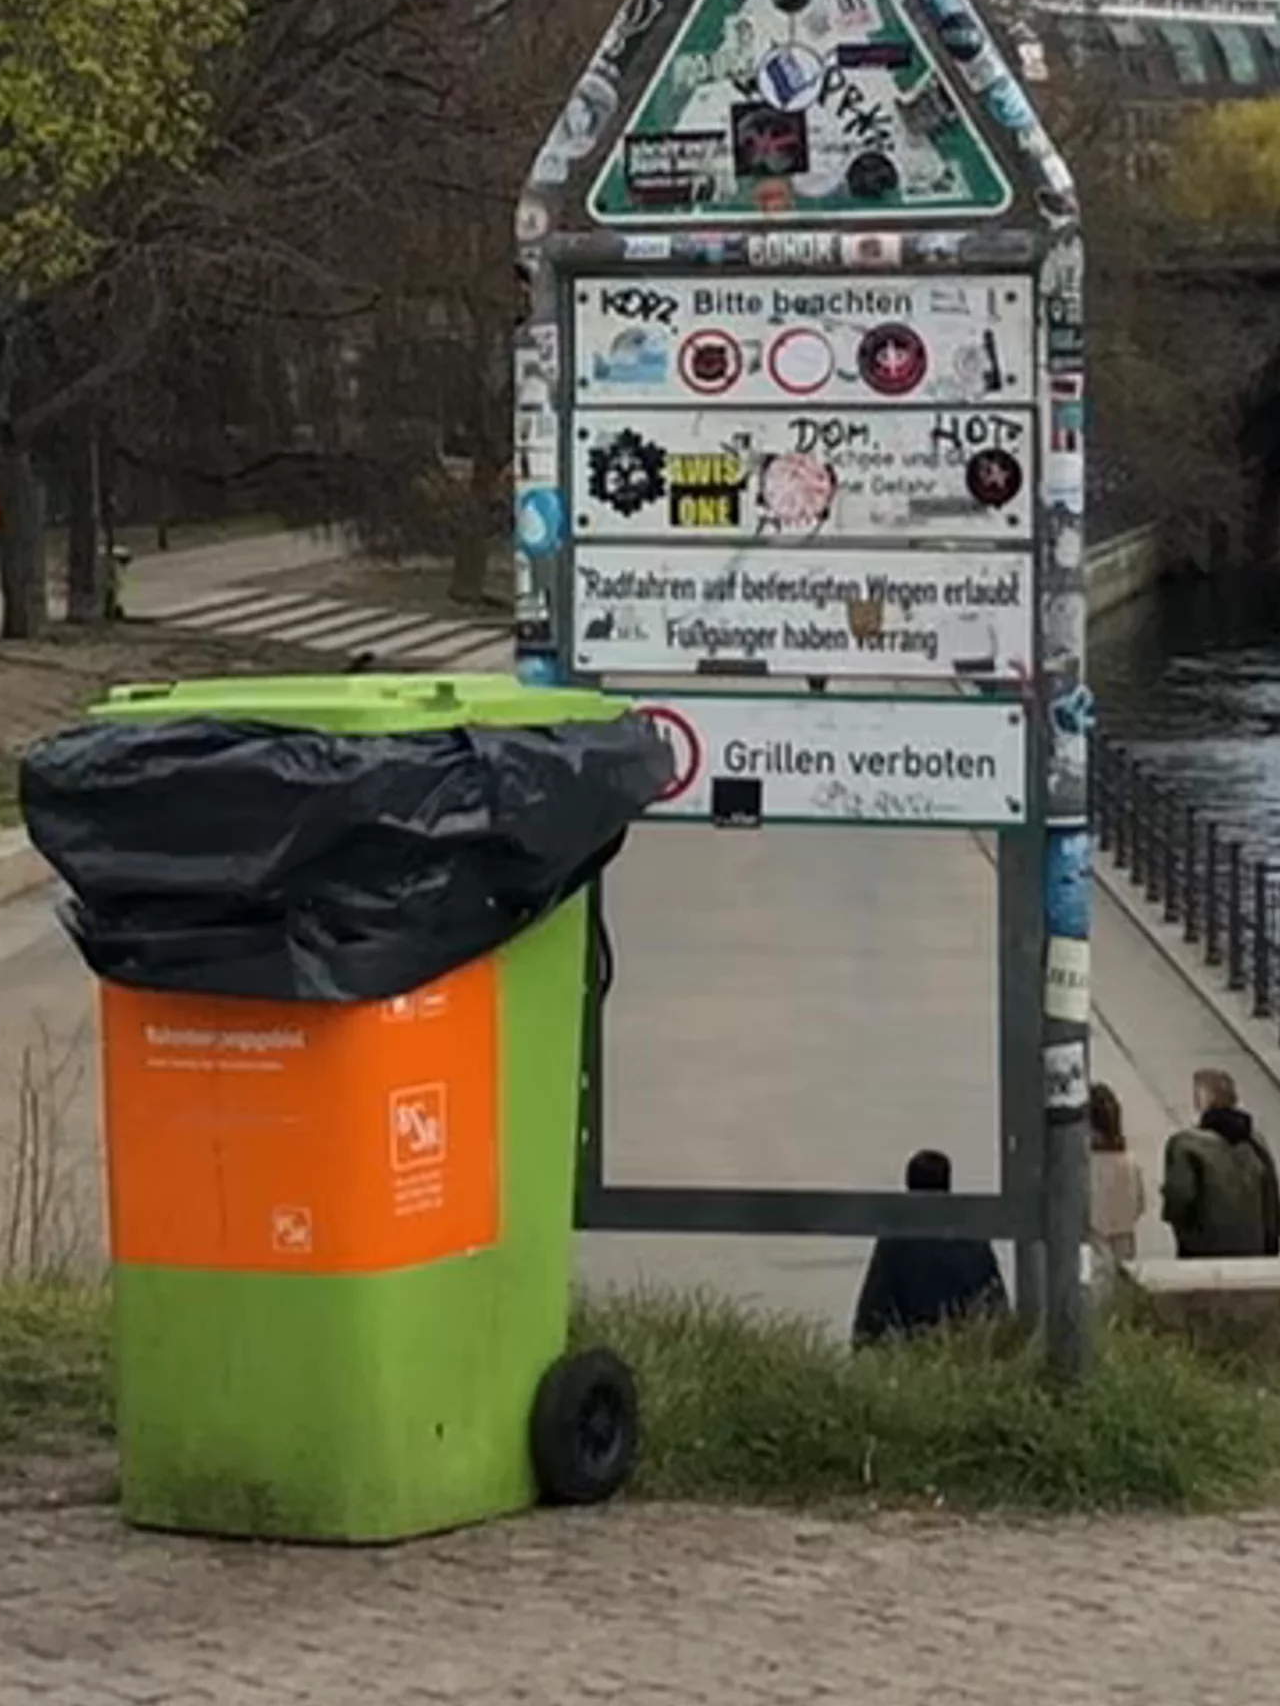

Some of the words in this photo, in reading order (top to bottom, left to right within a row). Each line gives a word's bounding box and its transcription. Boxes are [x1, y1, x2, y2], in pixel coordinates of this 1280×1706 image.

[694, 288, 763, 315] Bitte
[773, 288, 912, 316] beachten
[584, 568, 696, 601] Radfahren
[702, 570, 736, 601] auf
[741, 570, 860, 610] befestigten
[866, 574, 938, 614] Wegen
[943, 572, 1020, 607] erlaubt
[666, 618, 777, 657] Fußgänger
[783, 620, 849, 651] haben
[723, 739, 836, 775] Grillen
[848, 743, 996, 779] verboten
